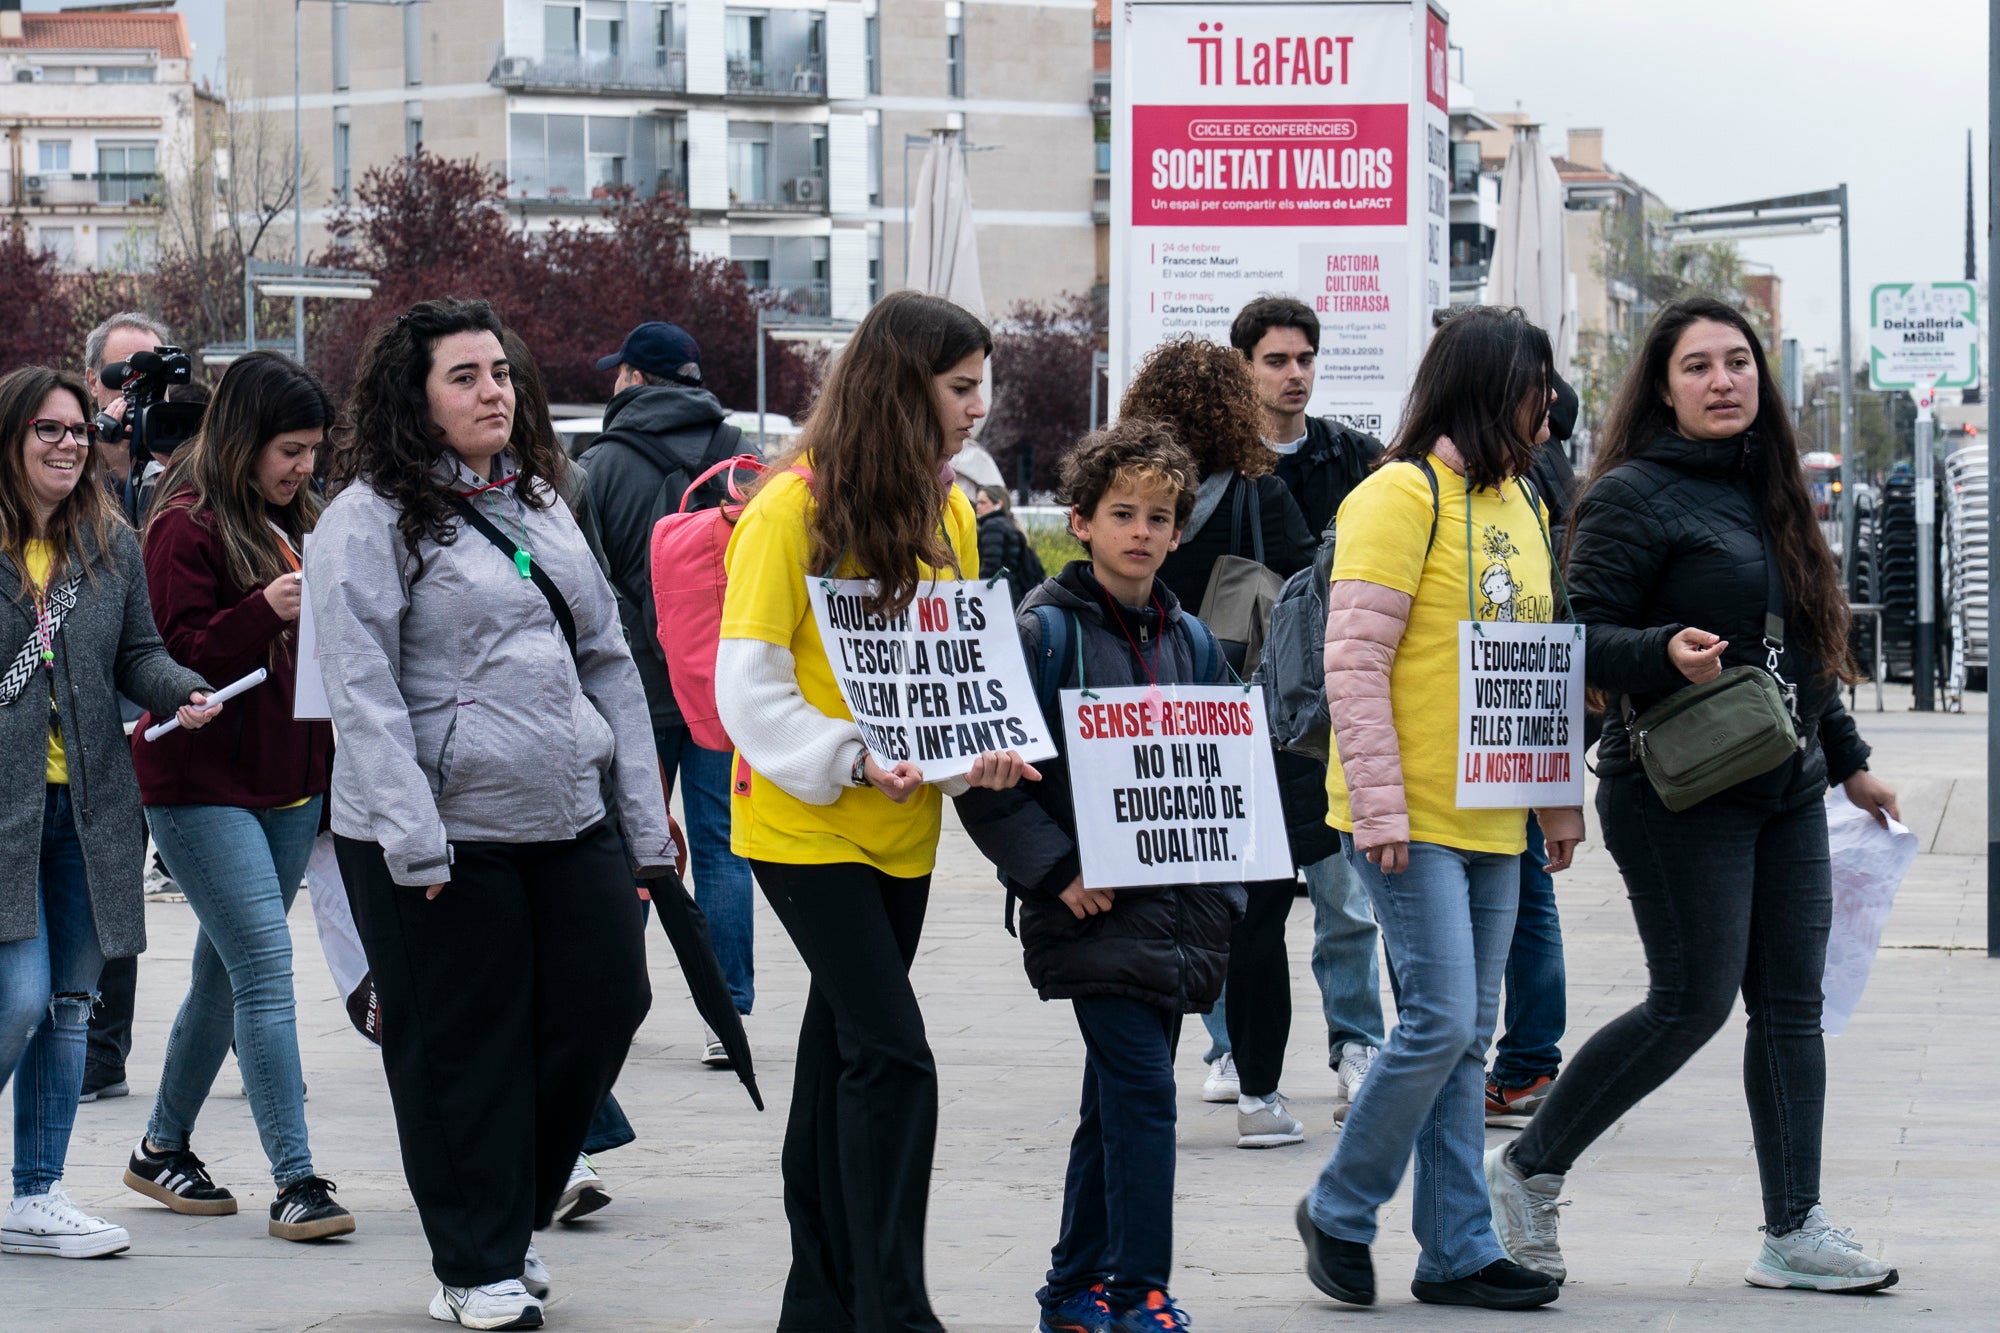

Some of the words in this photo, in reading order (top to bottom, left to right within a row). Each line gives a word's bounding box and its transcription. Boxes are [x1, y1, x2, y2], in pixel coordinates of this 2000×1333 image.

[1236, 36, 1354, 86] LaFACT
[1195, 123, 1231, 136] CICLE
[1234, 123, 1251, 136] DE
[1253, 121, 1350, 136] CONFERÈNCIES
[1152, 148, 1273, 190] SOCIETAT
[1278, 149, 1287, 189] I
[1293, 147, 1393, 190] VALORS
[1151, 199, 1168, 209] Un
[1169, 198, 1200, 211] espai
[1201, 201, 1220, 211] per
[1222, 198, 1277, 211] compartir
[1278, 198, 1295, 209] els
[1296, 198, 1331, 209] valors
[1332, 198, 1347, 209] de
[1349, 197, 1393, 209] LaFACT
[1162, 243, 1175, 252] 24
[1177, 243, 1189, 252] de
[1192, 243, 1221, 252] febrer
[1162, 256, 1208, 265] Francesc
[1210, 256, 1238, 265] Mauri
[1162, 269, 1172, 278] El
[1174, 269, 1197, 278] valor
[1199, 269, 1215, 278] del
[1217, 269, 1242, 278] medi
[1243, 269, 1284, 278] ambient
[1327, 255, 1380, 272] FACTORIA
[1162, 291, 1172, 301] 17
[1175, 291, 1187, 301] de
[1189, 293, 1215, 303] març
[1325, 275, 1380, 292] CULTURAL
[1162, 305, 1194, 314] Carles
[1196, 305, 1230, 314] Duarte
[1316, 295, 1329, 313] DE
[1333, 295, 1390, 313] TERRASSA
[1162, 318, 1197, 327] Cultura
[1204, 320, 1232, 328] perso
[1884, 317, 1963, 330] Deixalleria
[917, 596, 949, 633] NO
[955, 588, 987, 632] ÉS
[838, 636, 931, 676] L'ESCOLA
[935, 638, 986, 677] QUE
[1470, 635, 1546, 673] L'EDUCACIÓ
[1548, 642, 1571, 673] DELS
[843, 677, 900, 718] VOLEM
[905, 682, 951, 718] PER
[956, 678, 1008, 716] ALS
[1475, 677, 1532, 710] VOSTRES
[1535, 679, 1561, 710] FILLS
[1563, 679, 1568, 710] I
[1077, 702, 1154, 740] SENSE
[1161, 700, 1254, 737] RECURSOS
[1470, 715, 1512, 746] FILLES
[1516, 709, 1555, 747] TAMBÉ
[1556, 708, 1569, 747] ÉS
[915, 716, 1039, 761] INFANTS.
[1133, 743, 1165, 779] NO
[1171, 743, 1193, 778] HI
[1196, 743, 1222, 778] HA
[1464, 752, 1481, 783] LA
[1485, 752, 1533, 783] NOSTRA
[1536, 752, 1571, 783] LLUITA
[1112, 778, 1216, 823] EDUCACIÓ
[1220, 785, 1246, 819] DE
[1135, 827, 1238, 867] QUALITAT.
[365, 1010, 377, 1034] PER
